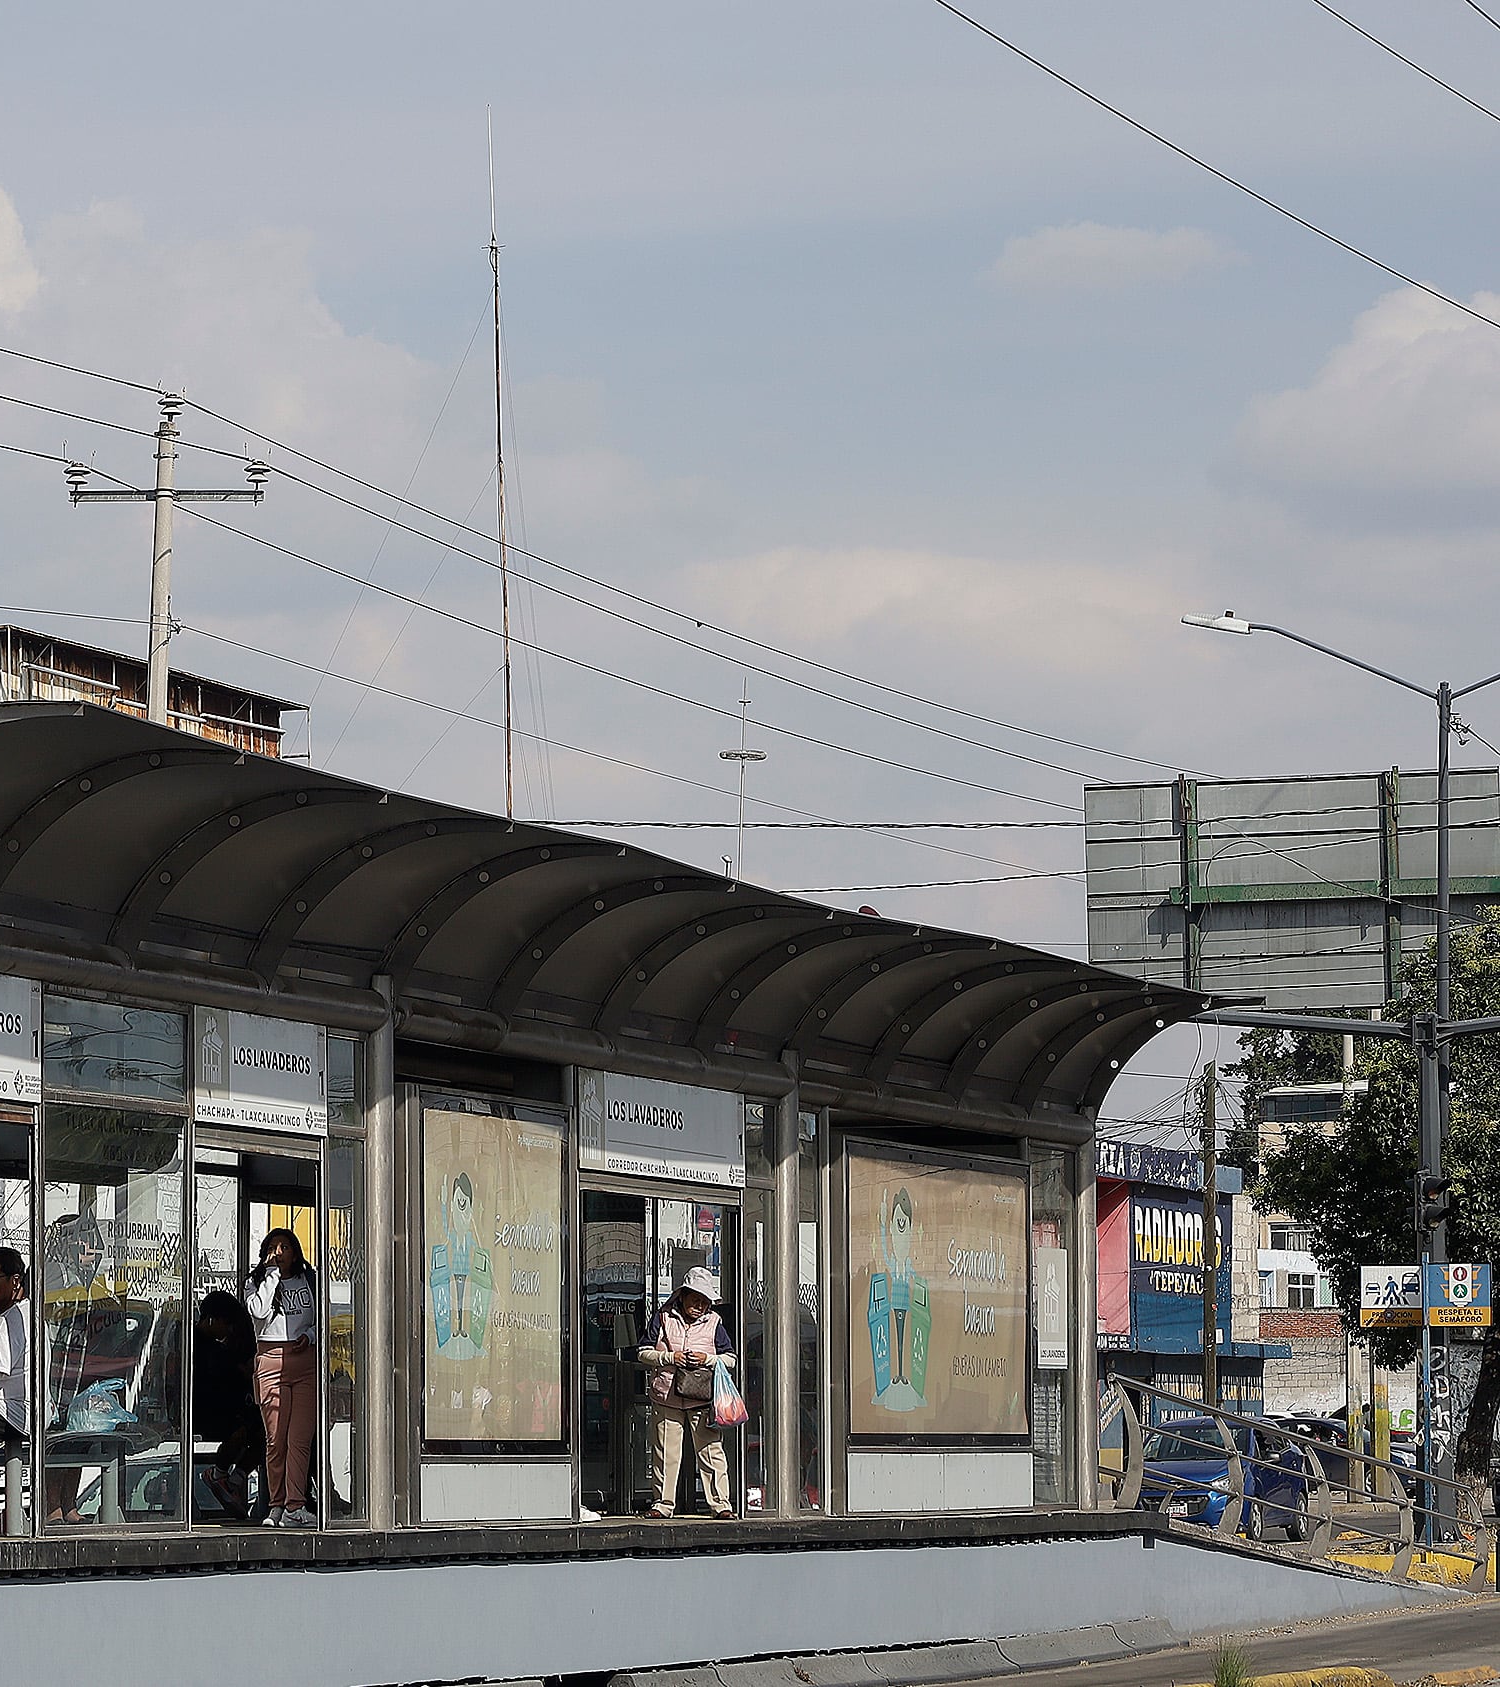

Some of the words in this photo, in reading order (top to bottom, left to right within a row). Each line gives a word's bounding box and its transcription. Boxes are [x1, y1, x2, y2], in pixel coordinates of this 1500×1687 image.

[233, 1046, 253, 1067] LOS
[253, 1049, 311, 1075] LAVADEROS
[196, 1104, 235, 1119] CHACHAPA
[241, 1109, 301, 1127] TLAXCALANCINGO
[607, 1099, 626, 1121] LOS
[628, 1103, 684, 1131] LAVADEROS
[607, 1158, 639, 1173] CORREDOR
[640, 1163, 669, 1175] CHACHAPA
[673, 1167, 720, 1182] TLAXCALANCINGO
[126, 1221, 159, 1242] URBANA
[1134, 1205, 1222, 1269] RADIADORS
[119, 1246, 159, 1262] TRANSPORTE
[947, 1236, 996, 1286] Separando
[998, 1237, 1006, 1281] la
[107, 1265, 159, 1283] ARTICULADO
[509, 1256, 540, 1296] basura
[964, 1289, 995, 1334] basura
